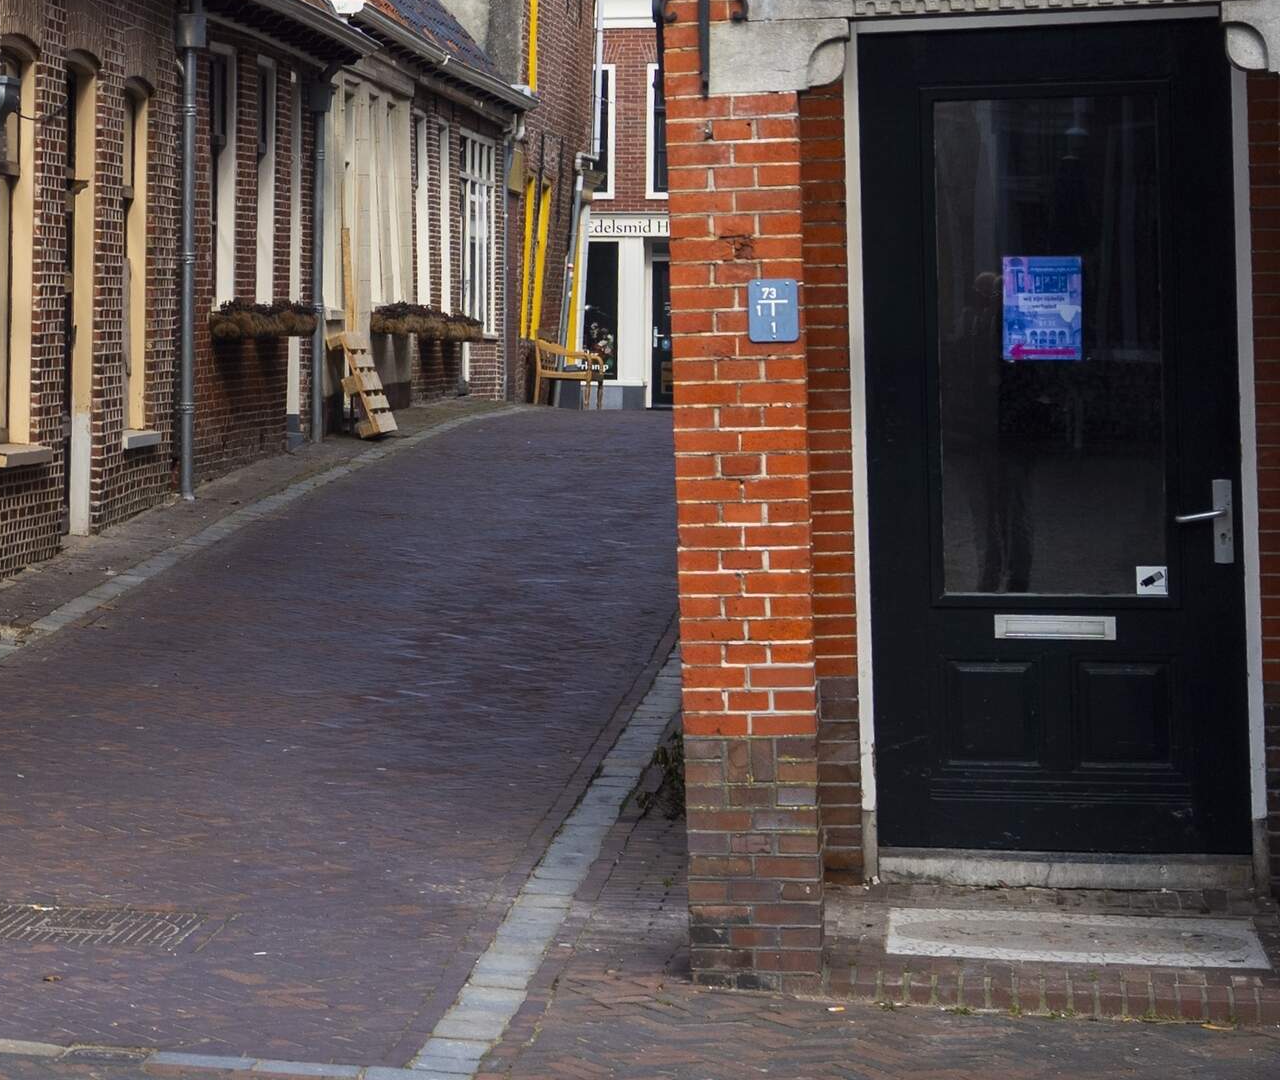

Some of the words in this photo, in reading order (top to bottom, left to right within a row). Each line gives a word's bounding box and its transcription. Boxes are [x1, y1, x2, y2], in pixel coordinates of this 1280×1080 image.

[761, 287, 777, 299] 73
[756, 305, 761, 317] 1
[771, 322, 776, 333] 1
